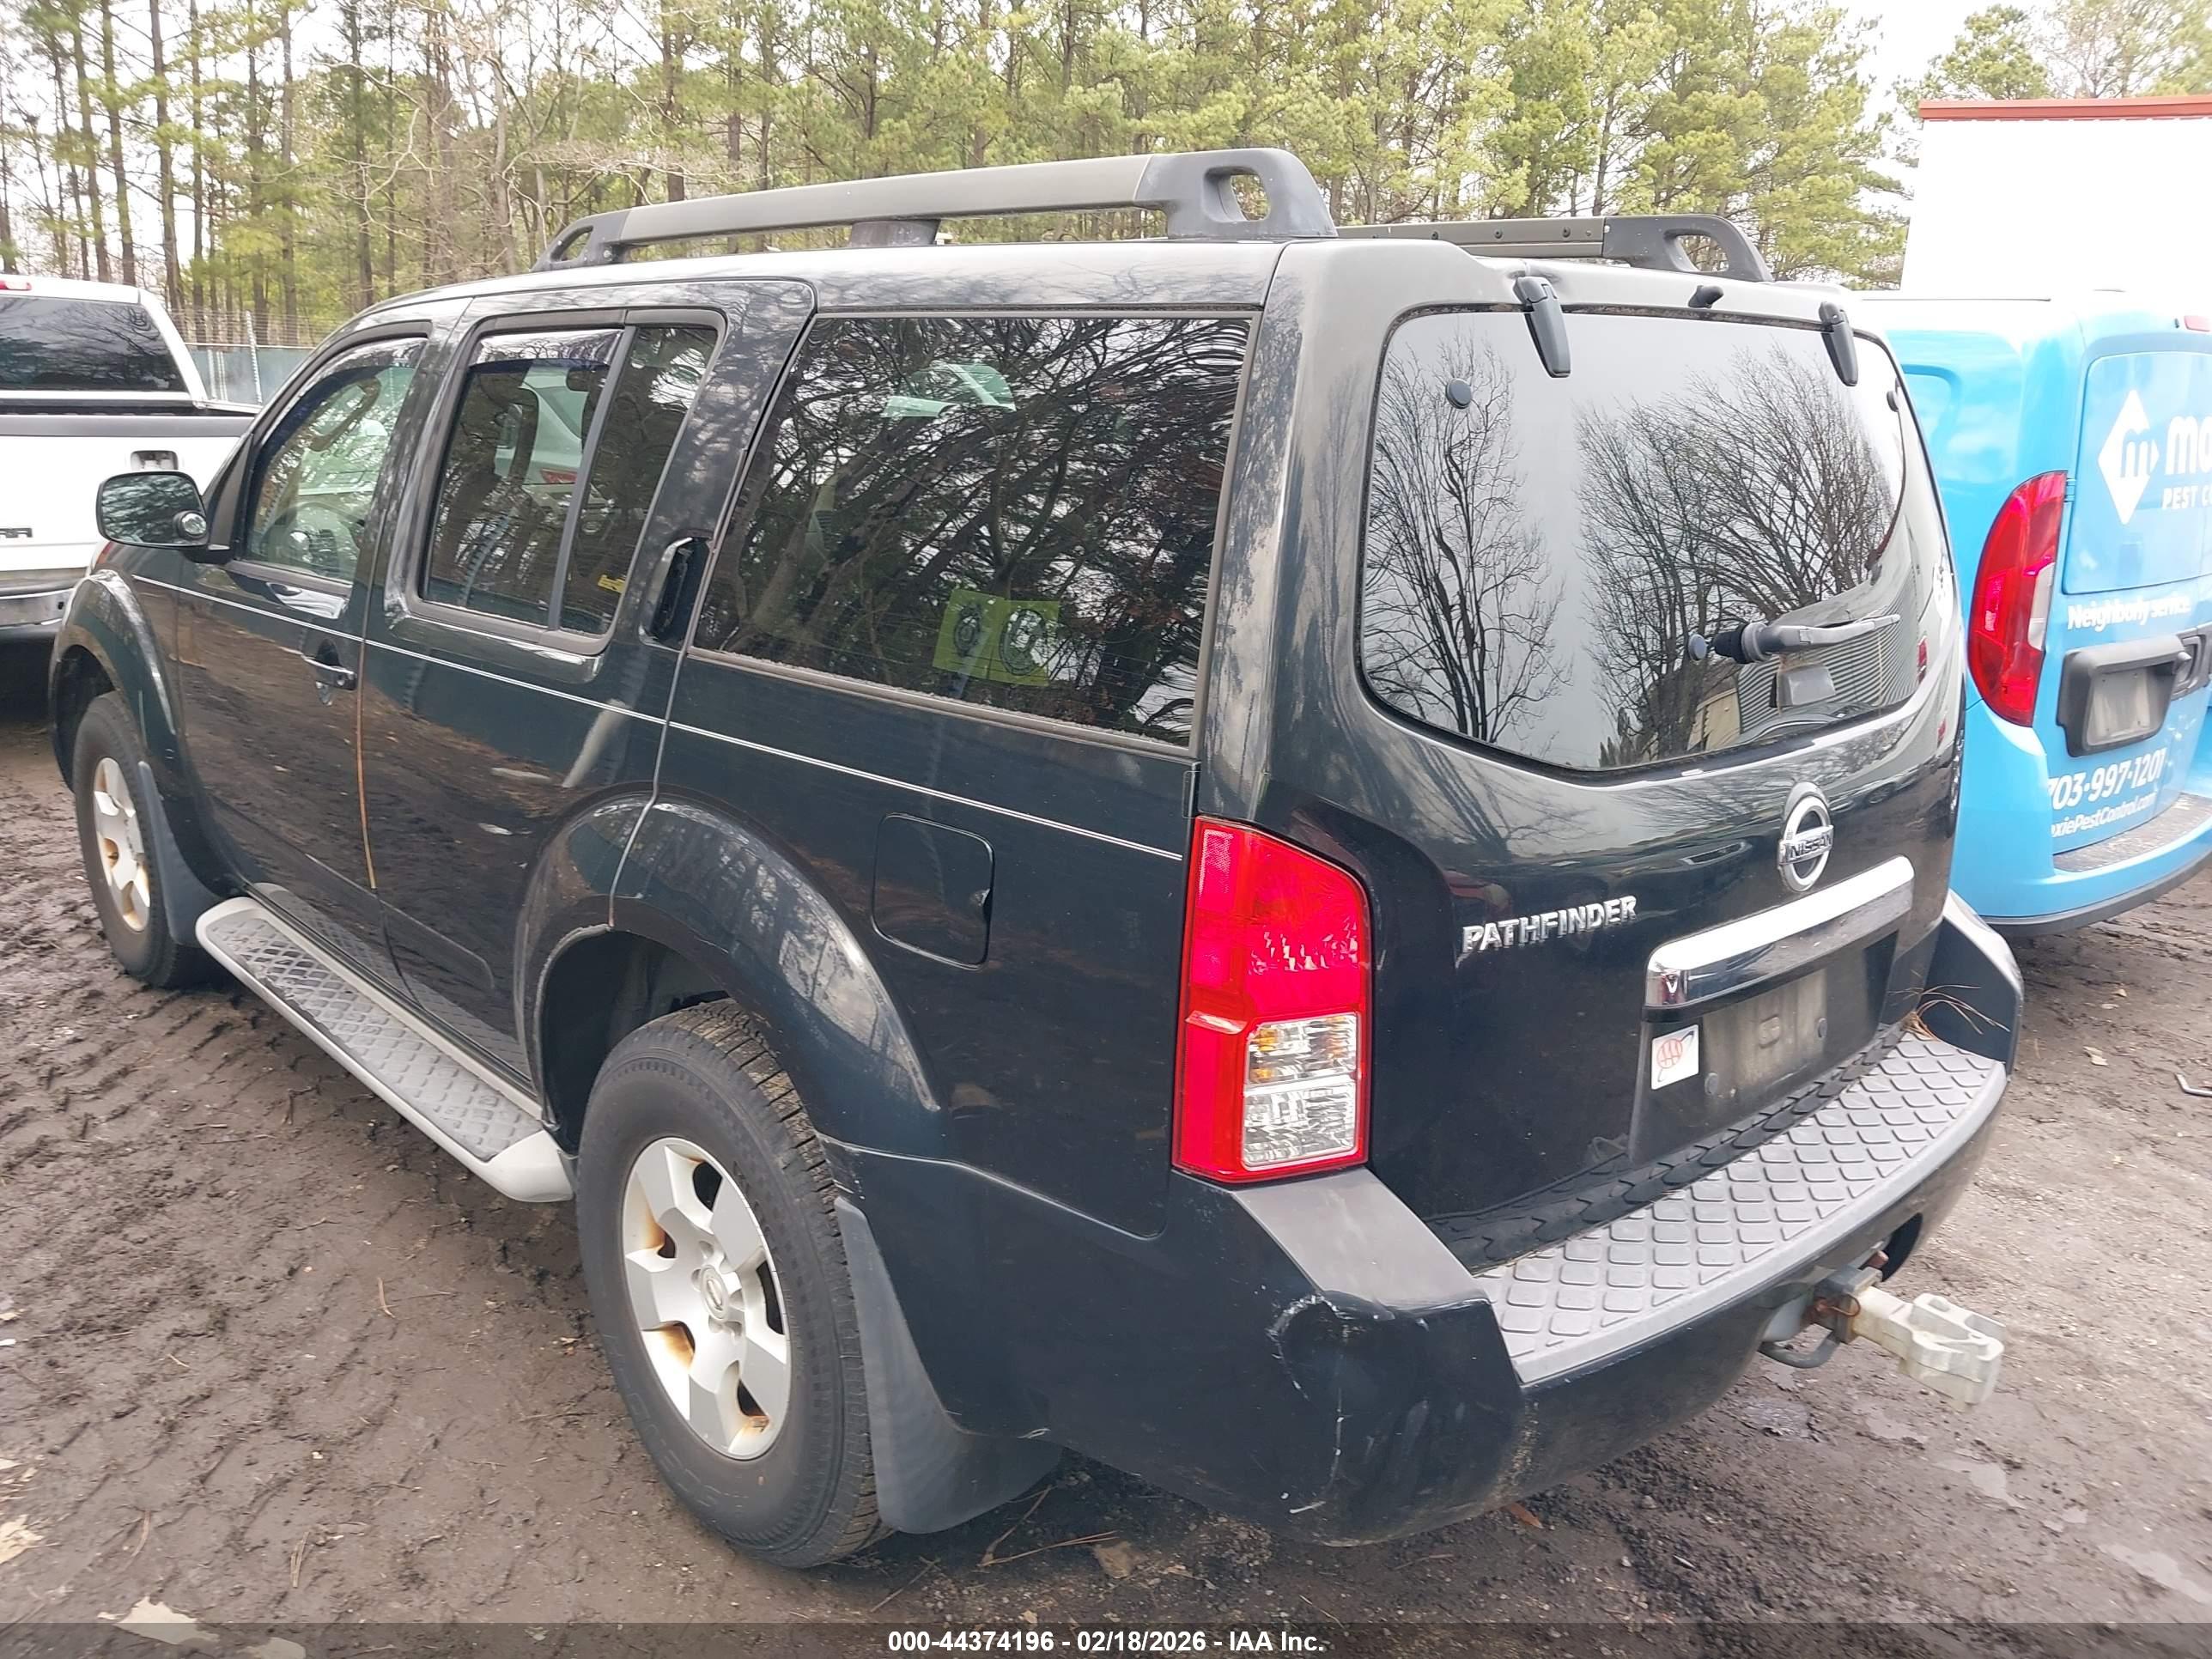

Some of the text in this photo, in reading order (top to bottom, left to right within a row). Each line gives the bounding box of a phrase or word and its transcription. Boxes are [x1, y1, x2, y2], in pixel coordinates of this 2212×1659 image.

[2161, 484, 2199, 510] PEST
[2067, 595, 2149, 632] Neighborly
[1789, 832, 1832, 861] NISSAN
[1462, 895, 1638, 953] PATHFINDER
